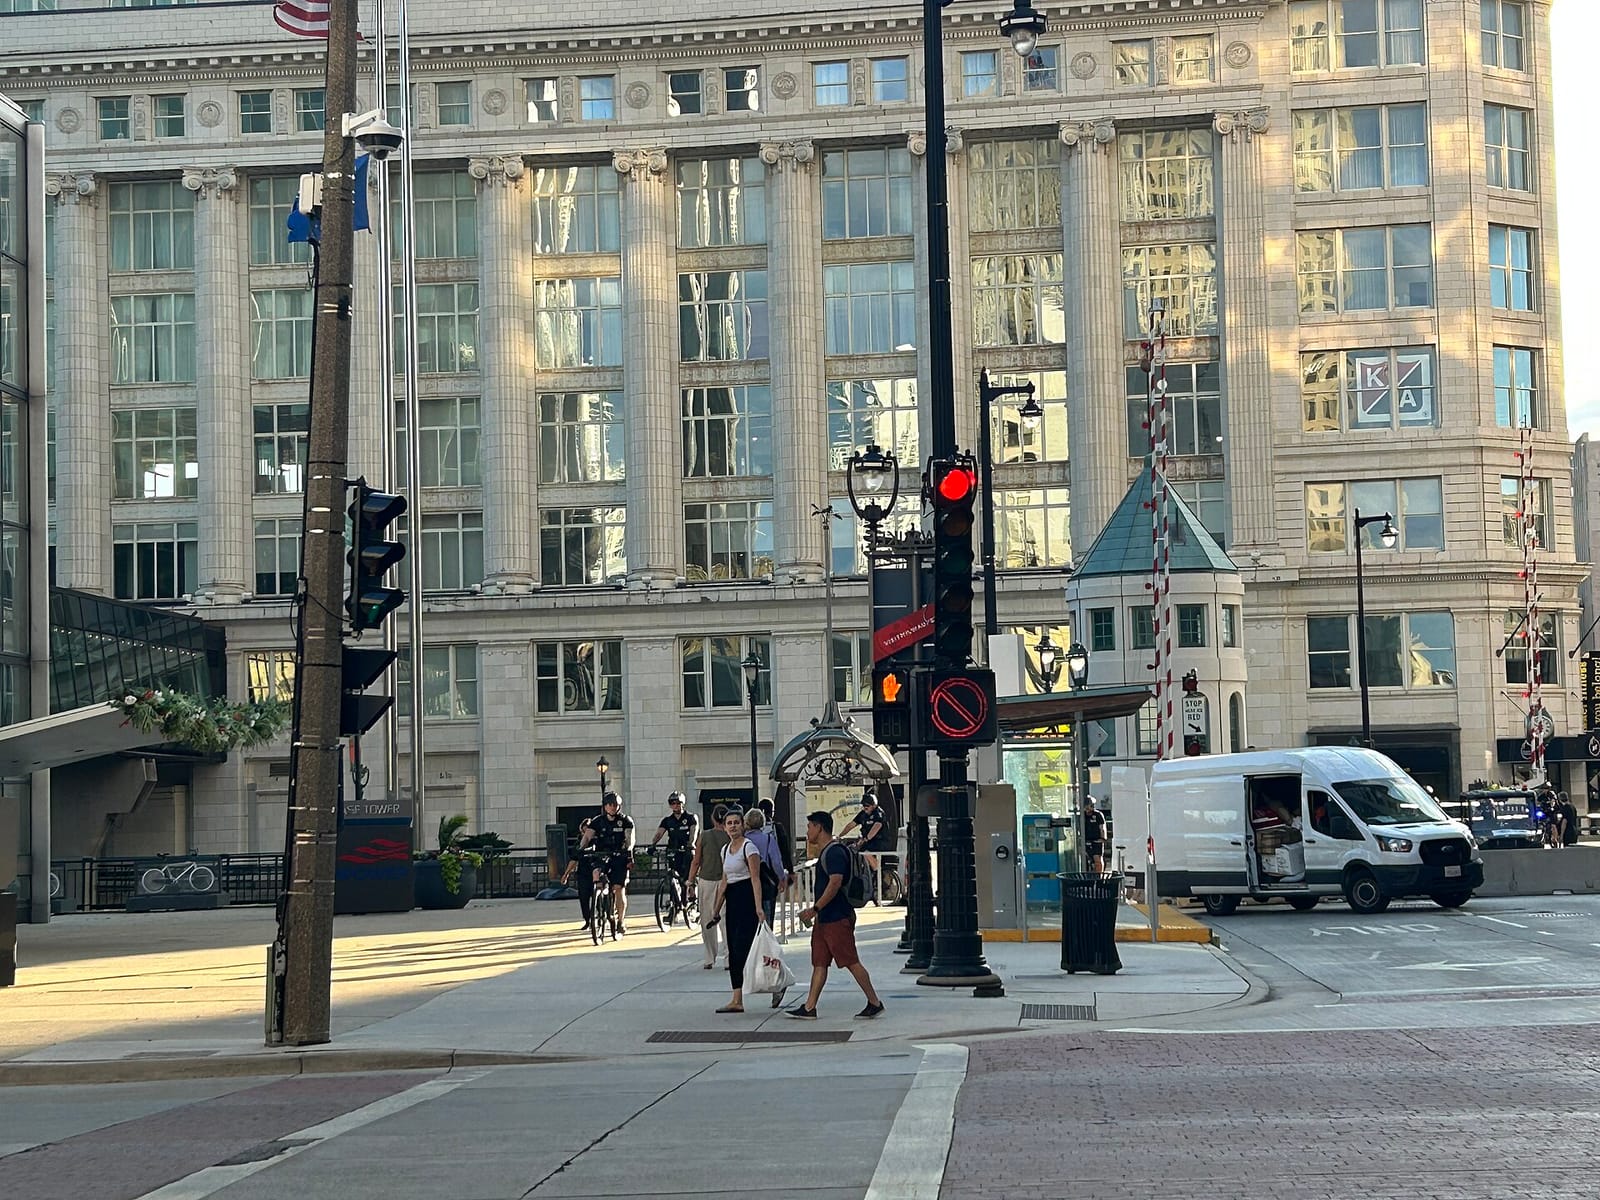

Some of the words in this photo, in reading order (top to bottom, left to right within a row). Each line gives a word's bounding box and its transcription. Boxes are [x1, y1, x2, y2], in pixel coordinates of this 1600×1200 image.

[1366, 367, 1384, 388] K
[1399, 389, 1417, 408] A
[1187, 713, 1201, 721] RED
[364, 804, 400, 814] TOWER
